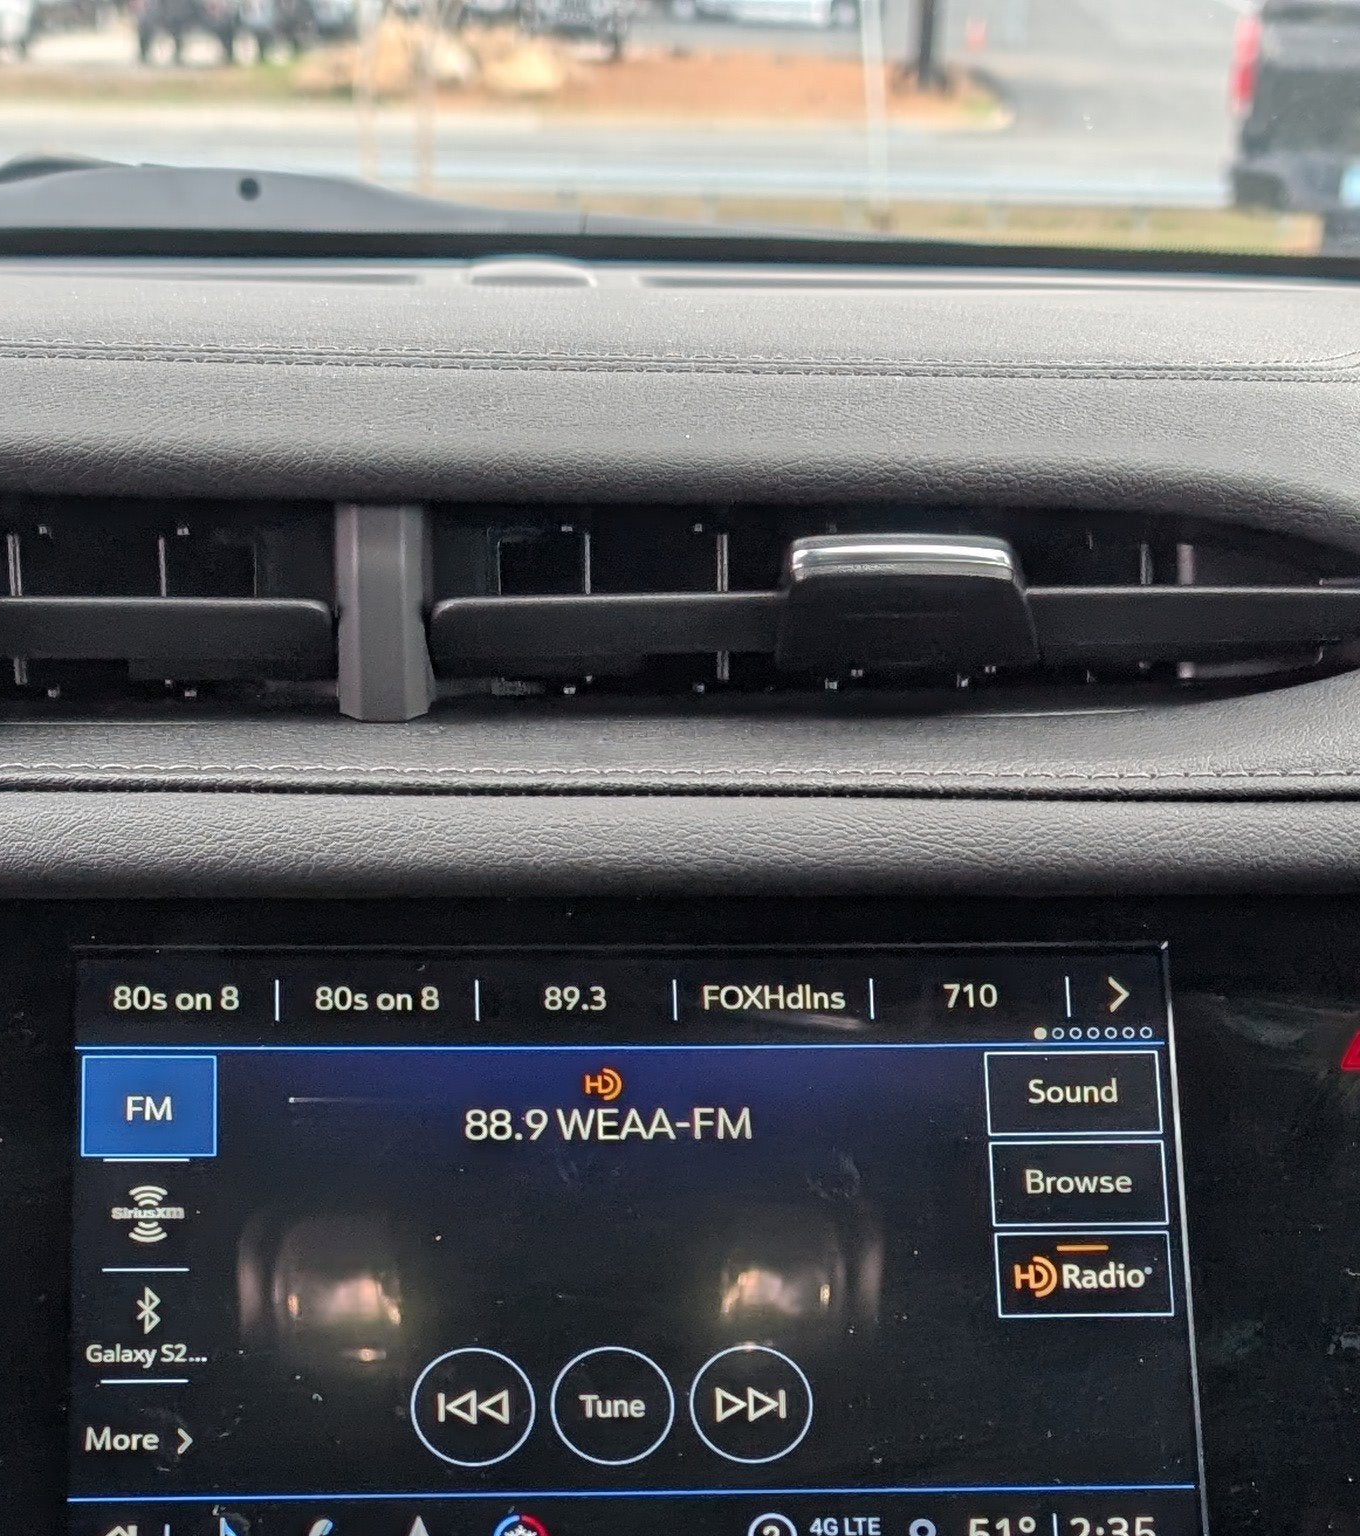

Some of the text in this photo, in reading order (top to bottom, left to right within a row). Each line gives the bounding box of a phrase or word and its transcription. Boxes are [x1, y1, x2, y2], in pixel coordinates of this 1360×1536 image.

[113, 984, 240, 1012] 80s on 8
[314, 984, 440, 1012] 80s on 8
[543, 984, 607, 1012] 89.3
[942, 982, 998, 1010] 710
[1028, 1077, 1118, 1104] Sound
[125, 1095, 173, 1122] FM
[463, 1107, 753, 1142] 88.9 WEAA-FM
[1025, 1169, 1133, 1194] Browse
[86, 1344, 157, 1368] Galaxy
[579, 1393, 646, 1418] Tune
[85, 1427, 159, 1451] More
[809, 1517, 881, 1536] 4G LTE
